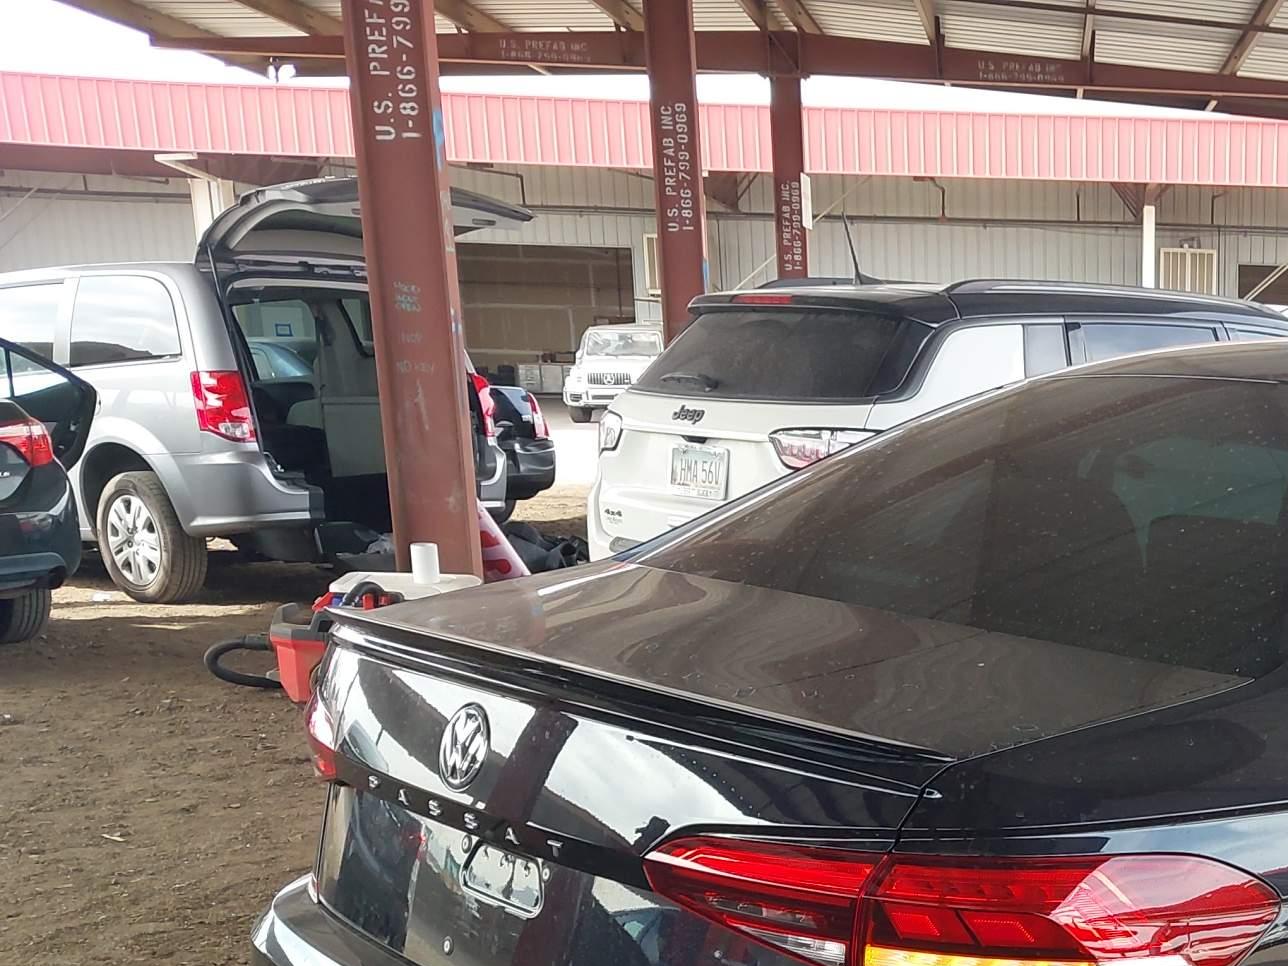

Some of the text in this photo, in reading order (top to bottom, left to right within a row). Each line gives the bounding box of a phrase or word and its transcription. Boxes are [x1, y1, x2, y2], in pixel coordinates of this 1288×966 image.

[373, 92, 396, 140] U.S.
[663, 137, 677, 196] PREFAB
[675, 102, 694, 231] 1-866-799-0969
[667, 203, 679, 232] U.S.
[782, 205, 792, 246] PREFAB
[672, 405, 705, 424] Jeep
[680, 456, 698, 484] HMA
[604, 508, 622, 517] 4x4
[368, 775, 564, 857] PASSAT
